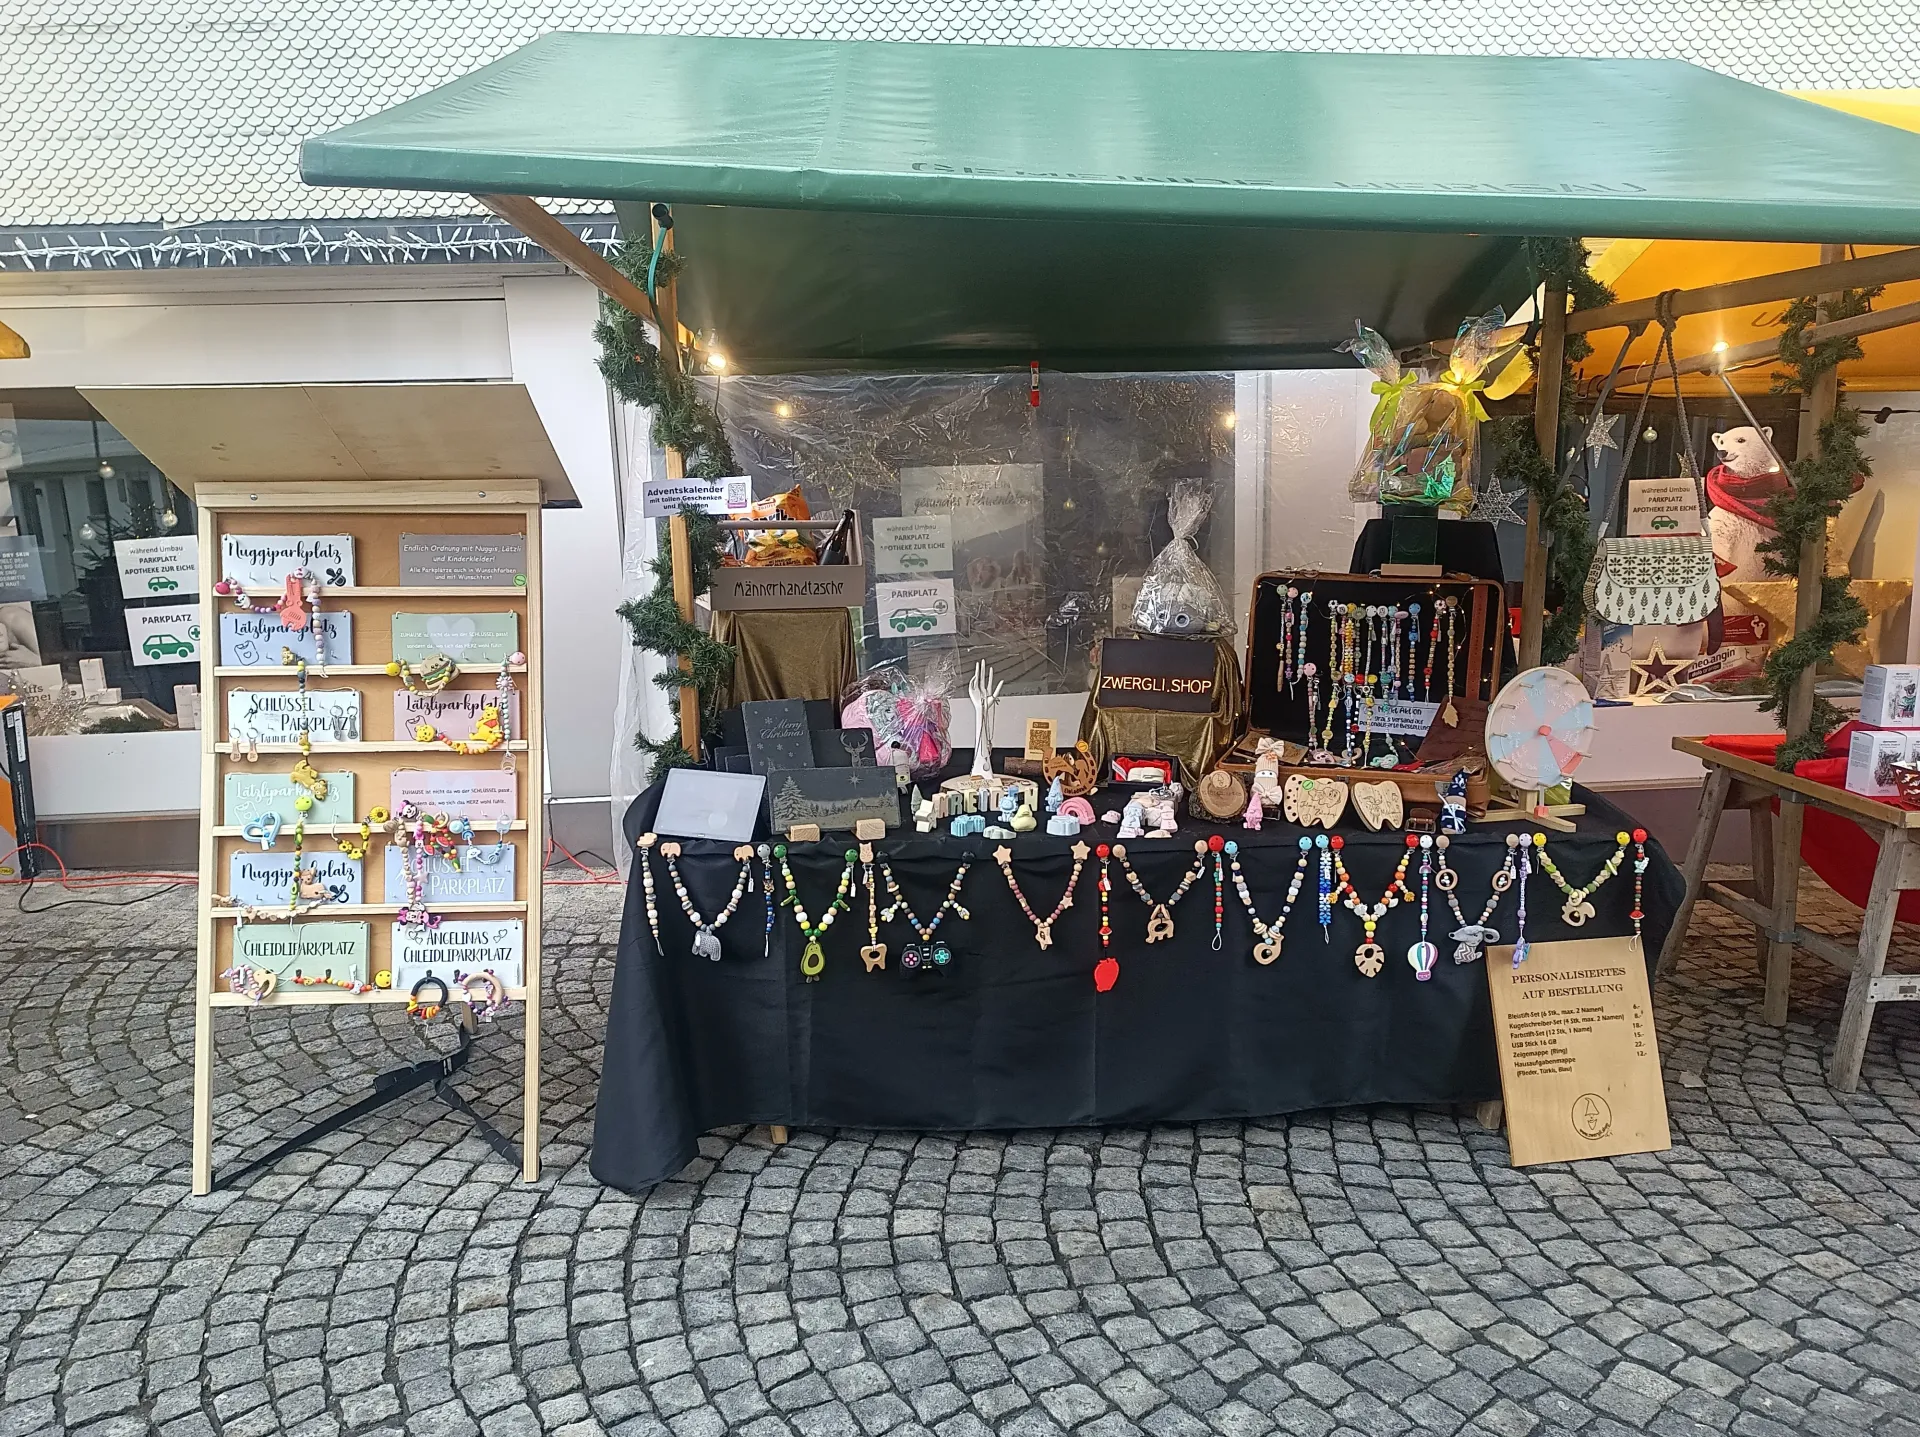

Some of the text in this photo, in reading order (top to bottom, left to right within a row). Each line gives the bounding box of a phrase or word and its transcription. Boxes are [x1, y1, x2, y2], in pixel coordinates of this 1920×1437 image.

[647, 486, 724, 497] Adventskalender
[682, 494, 723, 502] Geschenken
[129, 545, 184, 555] während Umbau
[229, 540, 342, 567] Nuggiparkplatz
[404, 544, 429, 552] Endlich
[430, 545, 460, 553] Ordnung
[139, 555, 177, 564] PARKPLATZ
[124, 566, 160, 575] APOTHEKE
[161, 565, 175, 573] ZUR
[734, 580, 844, 597] Männerhandtasche
[891, 588, 938, 598] PARKPLATZ
[142, 613, 193, 624] PARKPLATZ
[234, 617, 338, 641] Lätzliparpltz
[1101, 676, 1212, 694] ZWERGLI.SHOP
[251, 693, 315, 712] SCHLÜSSEL
[772, 718, 802, 731] Merry
[760, 728, 804, 739] Christmas
[236, 780, 340, 806] Lätzliparktz
[410, 854, 472, 874] CLÜSEL
[241, 859, 355, 887] Nuggipkplatz
[431, 875, 506, 896] PARKPLATZ
[426, 928, 489, 946] ANGELINAS
[243, 939, 356, 957] CHLEIDLIPARKPLATZ
[403, 947, 512, 963] CHLEIDLIPARKPLATZ
[1511, 967, 1627, 985] PERSONALISIERTES
[1522, 983, 1624, 1000] AUF BESTELLUNG
[1508, 1011, 1540, 1020] Bleistift-Set
[1509, 1019, 1562, 1030] Kugelschreiber-Set
[1511, 1031, 1545, 1039] Farbstift-Set
[1573, 1026, 1592, 1034] Name)
[1512, 1041, 1524, 1049] USB
[1513, 1048, 1568, 1058] Zeigemappe (Ring)
[1514, 1057, 1576, 1068] Hausaufgabenmappe
